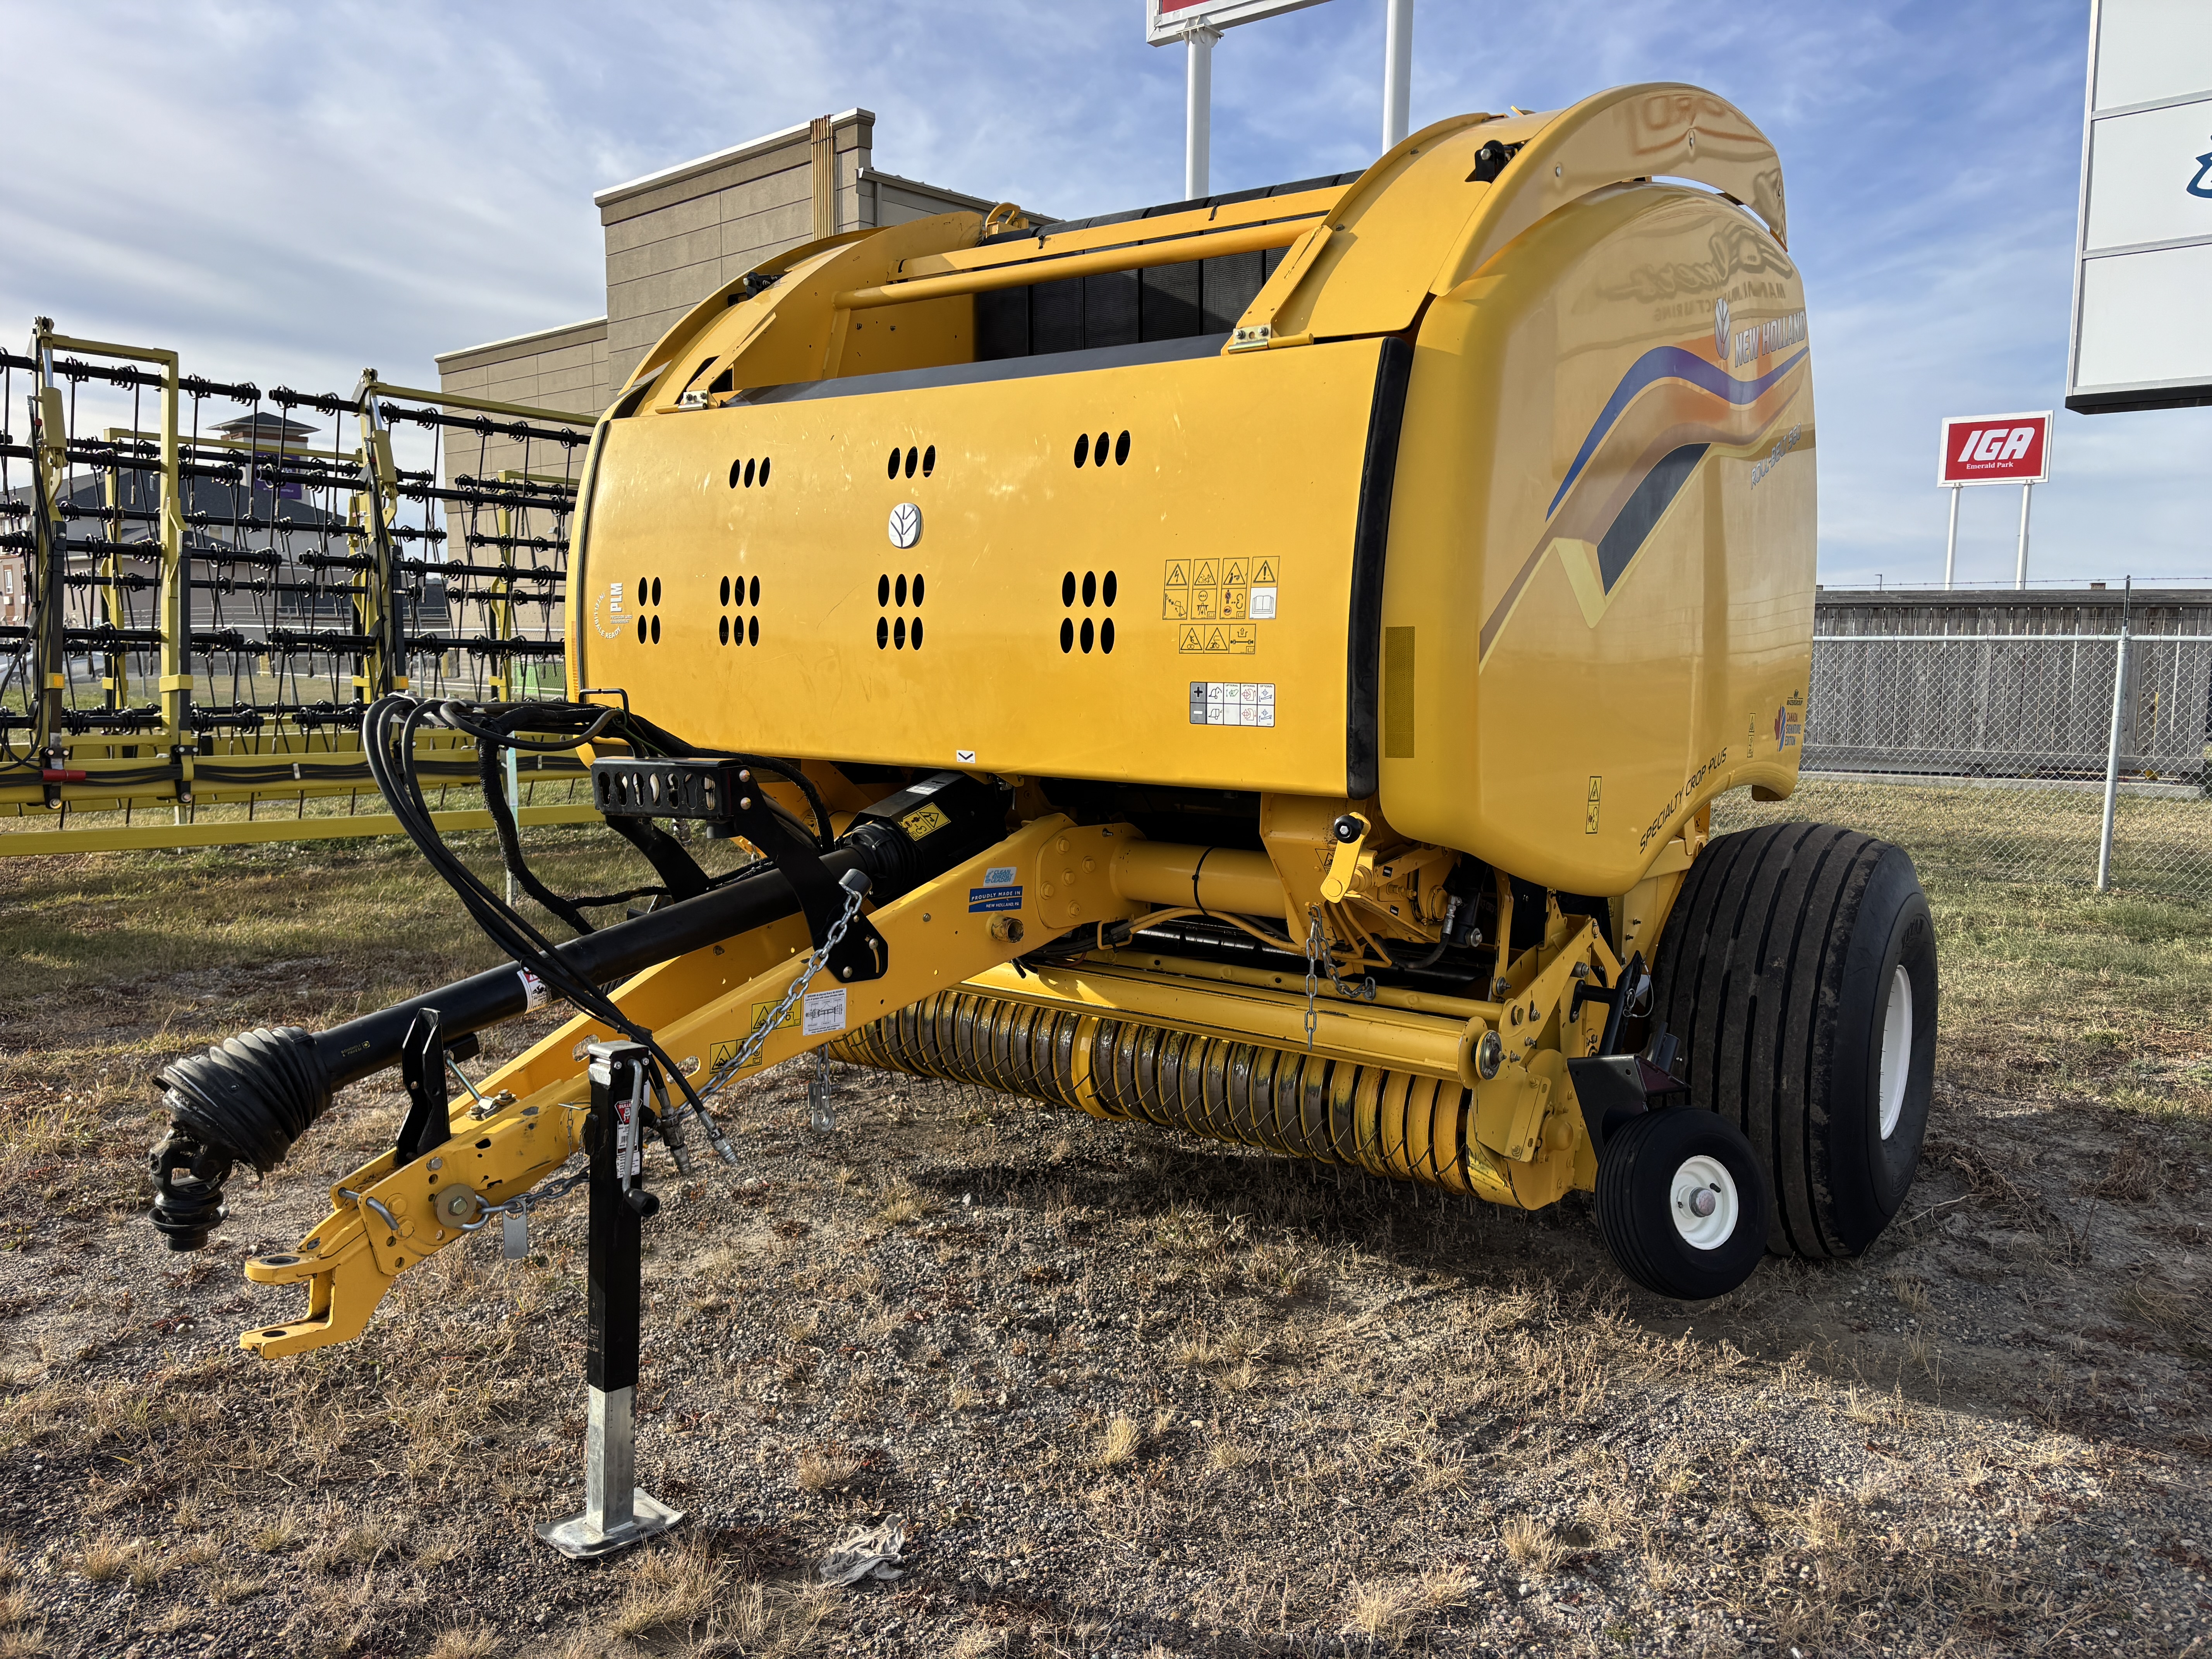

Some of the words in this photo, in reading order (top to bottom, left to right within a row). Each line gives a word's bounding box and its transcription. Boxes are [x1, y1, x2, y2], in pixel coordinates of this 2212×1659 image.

[1735, 325, 1760, 368] NEW
[1762, 311, 1806, 356] HOLLAND
[1751, 434, 1787, 490] ROLL-BELT
[1788, 421, 1801, 450] 560
[1958, 427, 2035, 462] IGA
[610, 582, 623, 613] PLM
[605, 625, 622, 639] READY
[1786, 712, 1798, 722] CANADA
[1640, 786, 1684, 855] SPECIALTY
[1686, 764, 1706, 797] CROP
[1709, 747, 1727, 774] PLUS
[972, 893, 996, 901] PROUDLY
